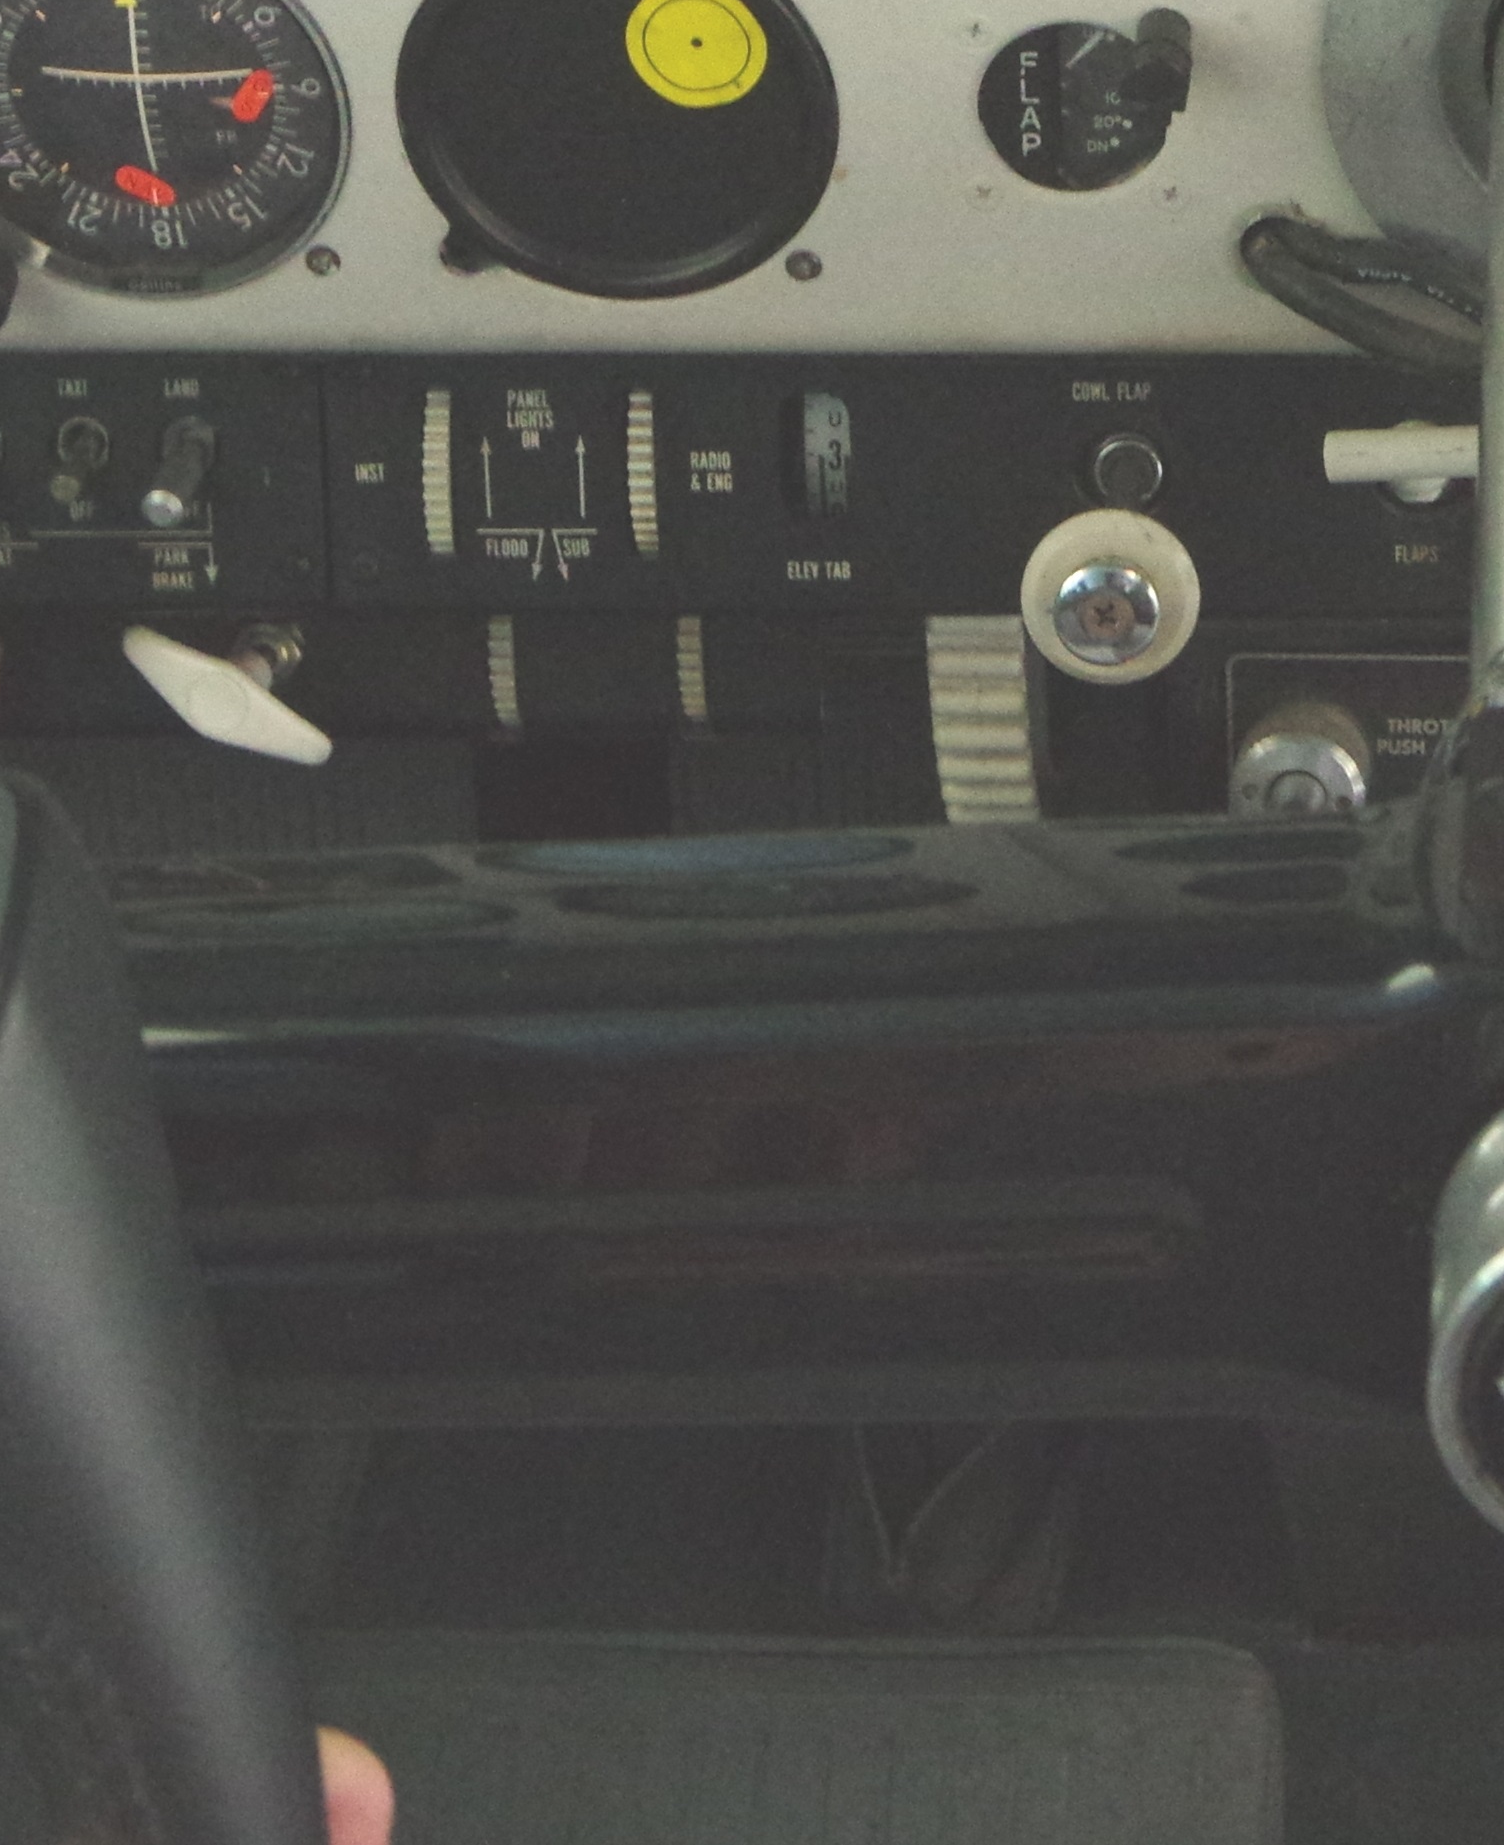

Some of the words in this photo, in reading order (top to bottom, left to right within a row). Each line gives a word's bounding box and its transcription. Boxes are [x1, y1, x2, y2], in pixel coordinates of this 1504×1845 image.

[508, 390, 549, 408] PANEL
[506, 410, 553, 429] LIGHTS
[1395, 545, 1438, 564] FLAPS
